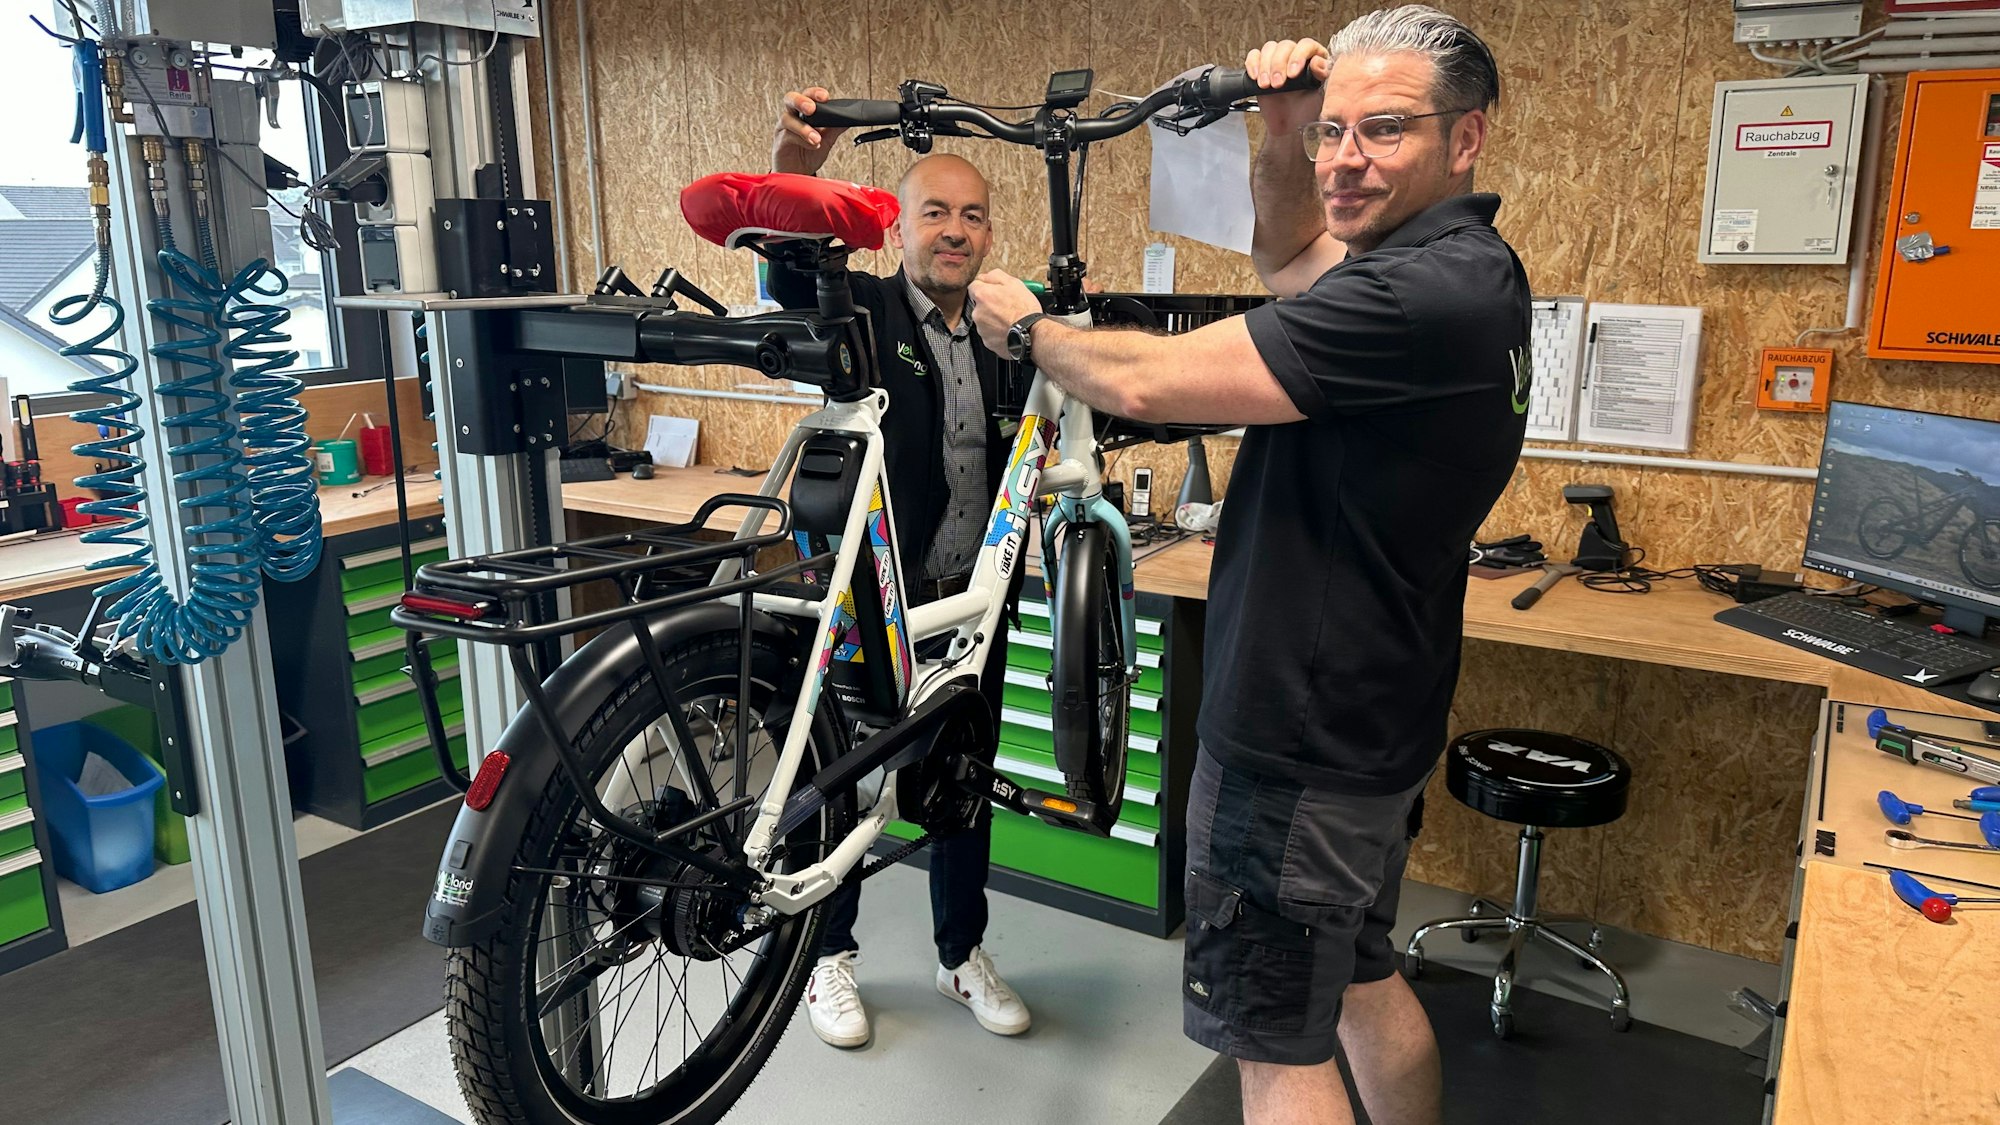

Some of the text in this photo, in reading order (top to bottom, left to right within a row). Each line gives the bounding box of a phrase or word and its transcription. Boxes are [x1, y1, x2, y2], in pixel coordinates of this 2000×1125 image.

[1745, 130, 1820, 142] Rauchabzug
[1767, 353, 1826, 363] RAUCHABZUG
[1782, 628, 1855, 656] SCHWALBE
[842, 694, 866, 704] BOSCH
[1487, 739, 1592, 774] VAR
